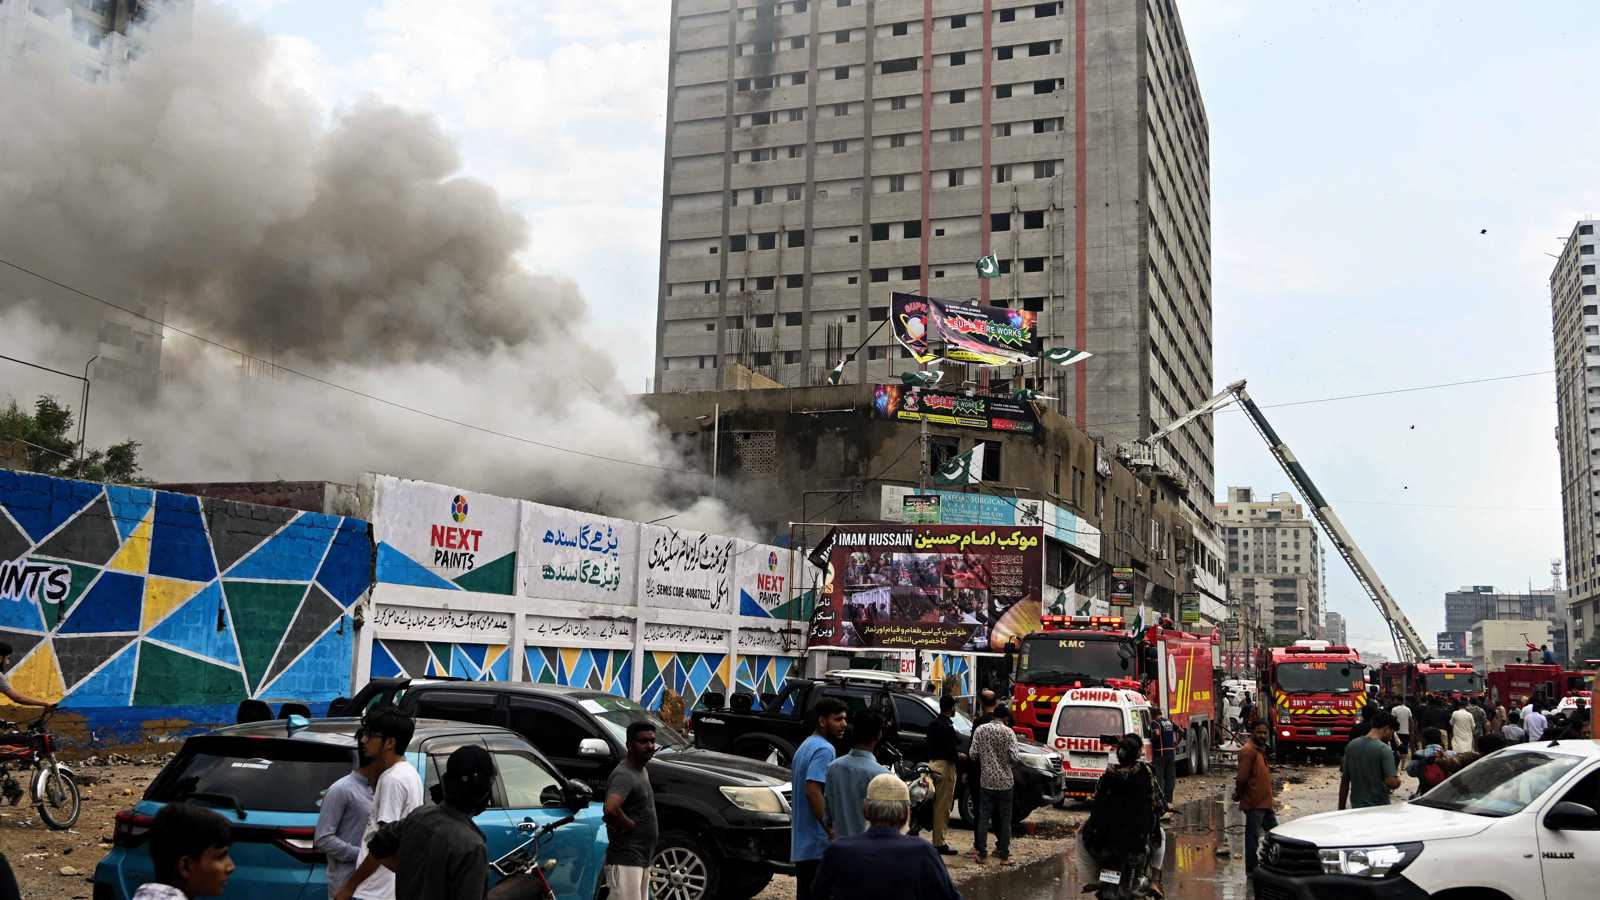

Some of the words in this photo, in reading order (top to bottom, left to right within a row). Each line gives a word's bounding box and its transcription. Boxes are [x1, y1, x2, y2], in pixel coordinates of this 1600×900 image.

[996, 326, 1022, 338] WORKS
[431, 524, 483, 552] NEXT
[542, 528, 578, 548] سندھ
[839, 532, 866, 546] IMAM
[869, 533, 912, 546] HUSSAIN
[959, 529, 996, 551] امام
[997, 530, 1038, 551] موکب
[434, 549, 475, 571] PAINTS
[542, 564, 577, 582] سندھ
[656, 583, 672, 597] SEMIS
[672, 586, 684, 598] CODE
[757, 573, 785, 593] NEXT
[758, 591, 781, 606] PAINTS
[1058, 639, 1086, 648] KMC
[901, 659, 915, 672] EXT
[1308, 662, 1328, 671] KMC
[1070, 690, 1118, 702] CHHIPA
[1054, 737, 1116, 752] CHHI
[1542, 851, 1575, 859] HILUX
